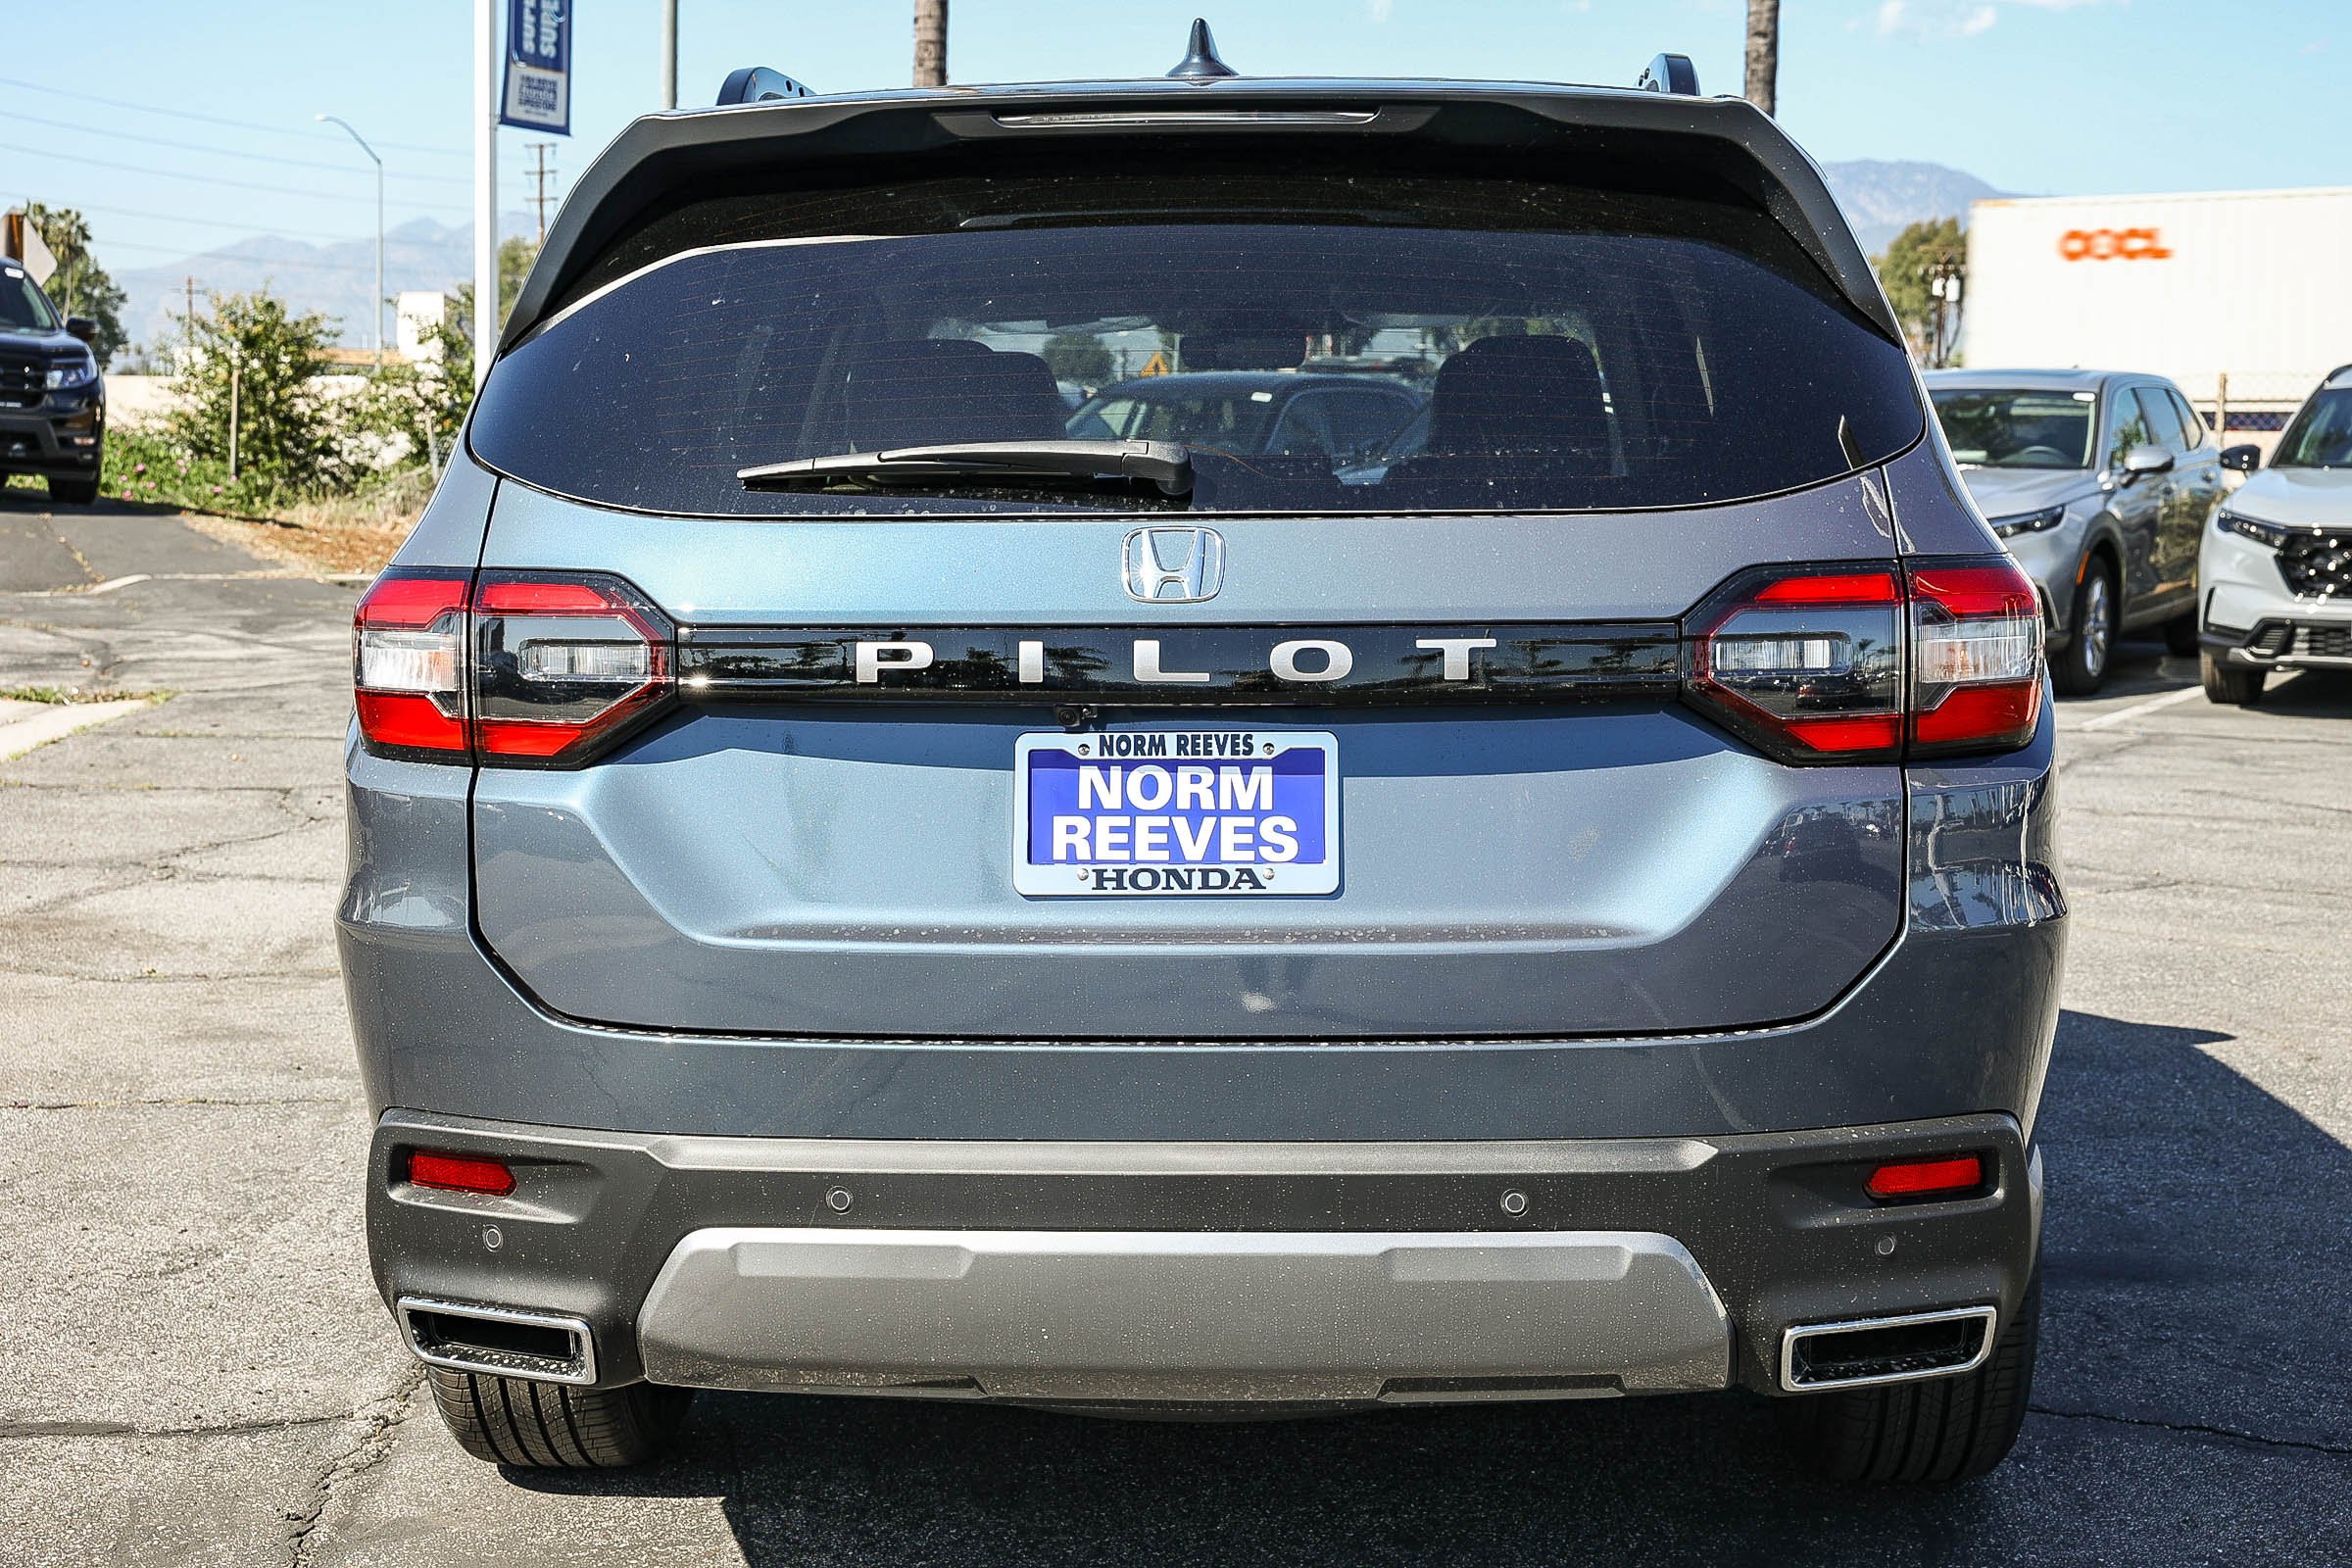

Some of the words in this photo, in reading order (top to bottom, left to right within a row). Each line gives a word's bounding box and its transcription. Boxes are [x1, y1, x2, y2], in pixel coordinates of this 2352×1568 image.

[856, 639, 1497, 683] PILOT
[1099, 734, 1166, 757] NORM
[1176, 733, 1254, 756] REEVES
[1079, 765, 1273, 810] NORM
[1053, 815, 1299, 862] REEVES
[1092, 867, 1266, 890] HONDA
